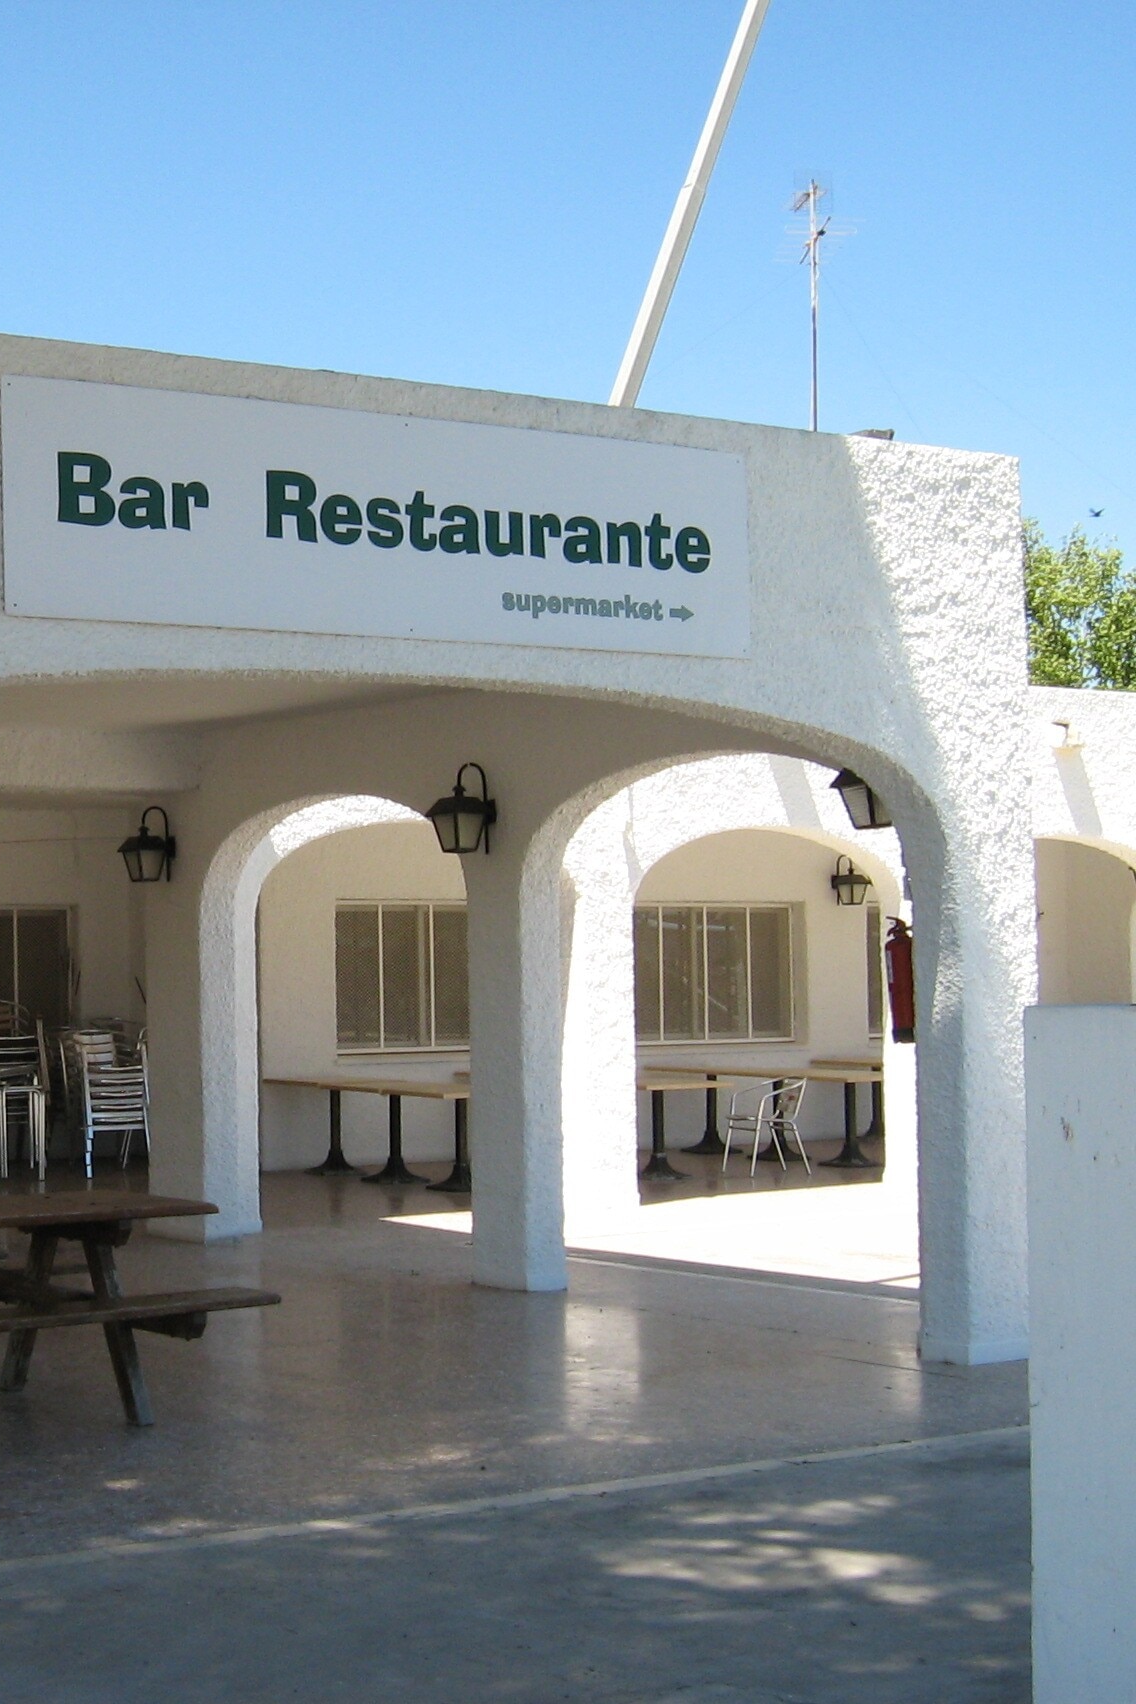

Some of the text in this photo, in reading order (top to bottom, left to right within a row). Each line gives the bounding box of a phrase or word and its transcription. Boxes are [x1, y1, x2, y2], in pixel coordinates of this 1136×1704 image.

[57, 450, 711, 574] Bar Restaurante
[501, 591, 664, 622] supermarket
